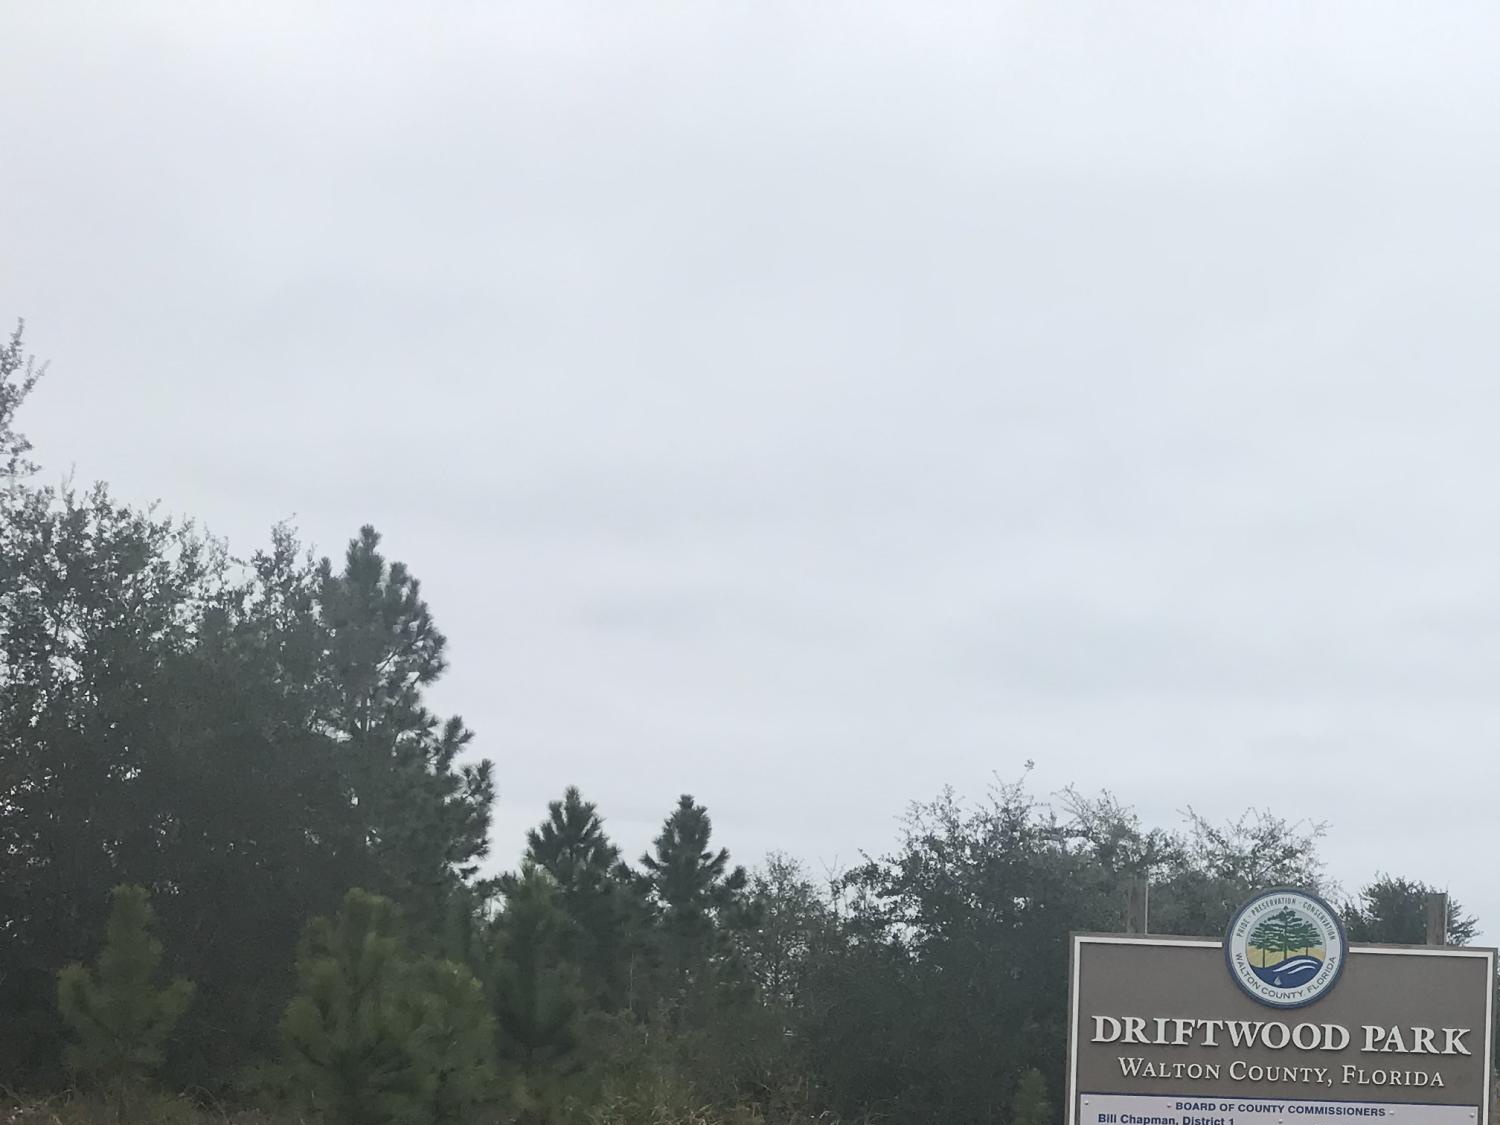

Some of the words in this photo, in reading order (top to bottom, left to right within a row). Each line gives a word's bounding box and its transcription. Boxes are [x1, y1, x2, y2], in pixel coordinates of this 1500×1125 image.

[1251, 898, 1296, 916] PRESERVATION
[1303, 902, 1337, 940] CONSERVATION
[1235, 952, 1261, 990] WALTON
[1306, 956, 1337, 994] FLORIDA
[1091, 1015, 1350, 1050] DRIFTWOOD
[1360, 1025, 1472, 1056] PARK
[1118, 1056, 1221, 1079] WALTON
[1341, 1064, 1445, 1087] FLORIDA
[1097, 1113, 1117, 1124] Bill
[1175, 1102, 1216, 1112] BOARD
[1219, 1103, 1235, 1112] OF
[1237, 1104, 1285, 1114] COUNTY
[1287, 1105, 1386, 1117] COMMISSIONERS
